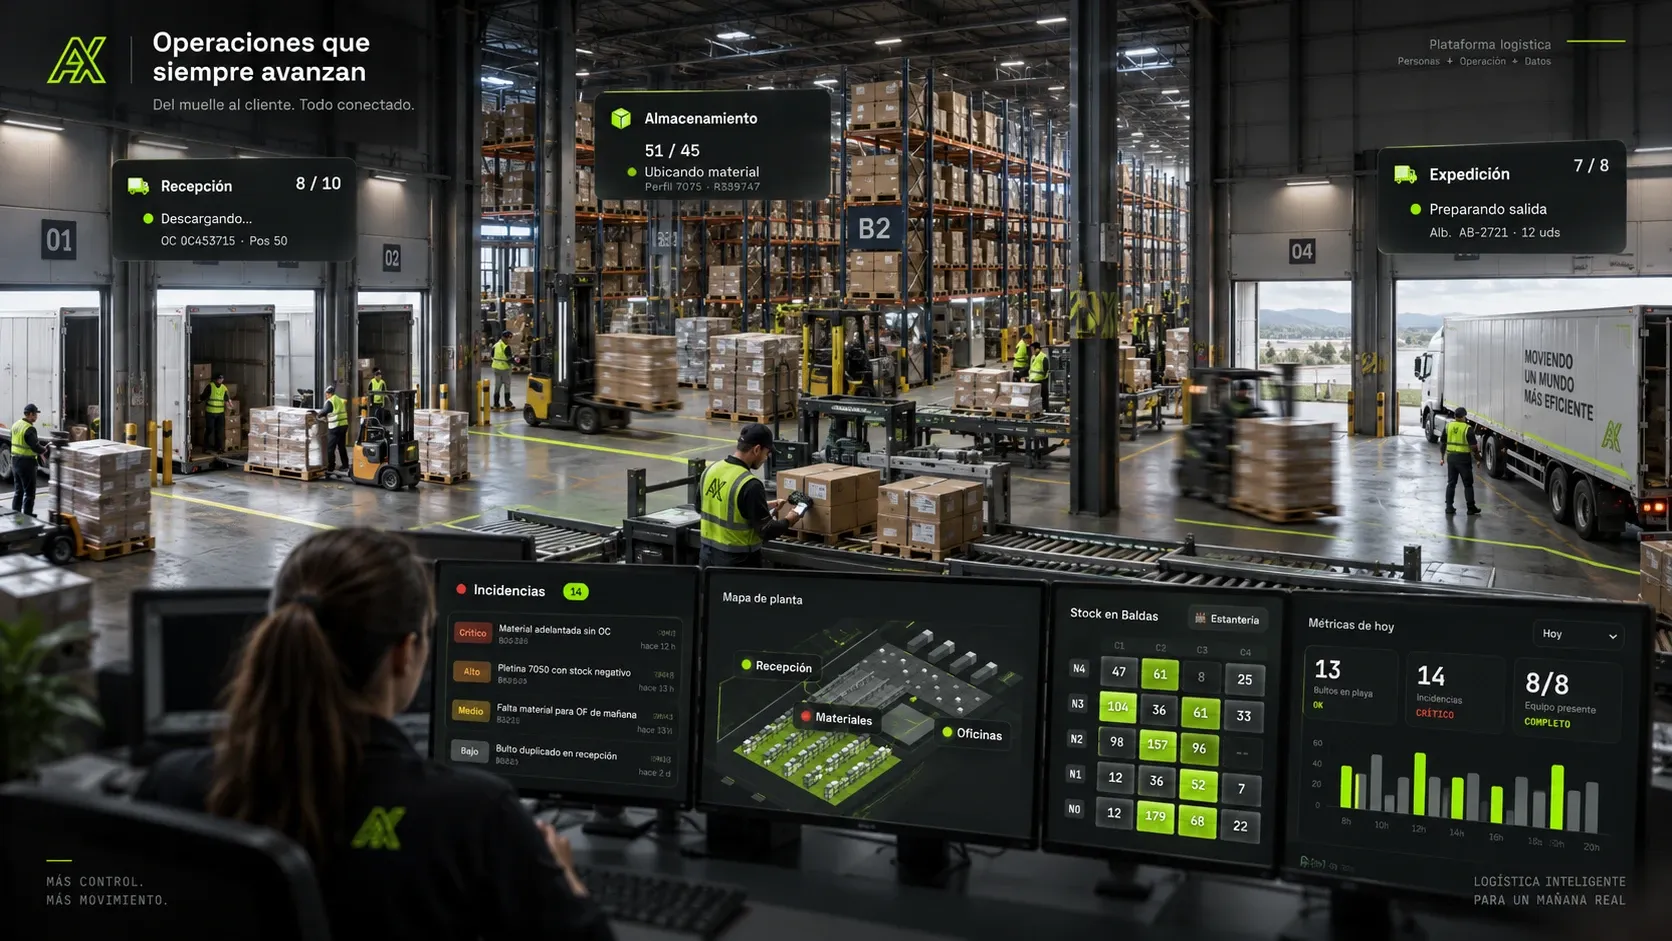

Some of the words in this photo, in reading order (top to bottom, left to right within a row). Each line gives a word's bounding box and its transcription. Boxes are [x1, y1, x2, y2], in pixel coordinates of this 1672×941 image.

[859, 217, 890, 239] B2
[46, 227, 72, 253] 01
[384, 249, 399, 266] 02
[1291, 243, 1313, 260] 04
[1524, 349, 1573, 370] MOVIENDO
[1525, 370, 1536, 385] UN
[1539, 372, 1575, 393] MUNDO
[1524, 388, 1542, 406] MÁS
[1544, 393, 1594, 422] EFICIENTE
[474, 584, 546, 597] Incidencias
[570, 588, 582, 596] 14
[723, 592, 751, 604] Mapa
[754, 594, 767, 604] de
[770, 595, 802, 606] planta
[1070, 608, 1102, 620] Stock
[1105, 610, 1118, 620] en
[1122, 610, 1158, 622] Baldas
[499, 624, 532, 634] Material
[535, 626, 581, 635] adelantada
[584, 627, 596, 636] sin
[598, 627, 611, 636] OC
[1308, 618, 1355, 630] Métricas
[1358, 620, 1372, 632] de
[1374, 621, 1394, 634] hoy
[1542, 629, 1562, 640] Hoy
[1114, 642, 1124, 650] C1
[1156, 644, 1166, 652] C2
[1197, 646, 1208, 654] C3
[1240, 648, 1251, 656] C4
[464, 668, 480, 676] Alto
[498, 664, 526, 673] Pletina
[528, 666, 550, 674] 7050
[570, 666, 592, 676] stock
[594, 668, 631, 678] negativo
[756, 660, 812, 675] Recepción
[1073, 664, 1086, 674] N4
[1112, 667, 1126, 676] 47
[1154, 669, 1167, 680] 61
[1198, 672, 1204, 682] 8
[1238, 674, 1252, 685] 25
[1315, 660, 1341, 680] 13
[1418, 666, 1445, 686] 14
[1525, 672, 1569, 696] 8/8
[1314, 686, 1338, 696] Bultos
[1352, 688, 1373, 699] playa
[458, 706, 484, 716] Medio
[497, 704, 518, 712] Falta
[520, 705, 553, 714] material
[555, 708, 574, 717] para
[576, 708, 588, 716] OF
[1072, 699, 1084, 709] N3
[1108, 702, 1128, 712] 104
[1152, 705, 1166, 716] 36
[1194, 708, 1208, 718] 61
[1236, 710, 1251, 721] 33
[1416, 708, 1454, 720] CRÍTICO
[1525, 702, 1554, 714] Equipo
[1557, 704, 1596, 715] presente
[816, 712, 872, 726] Materiales
[1524, 718, 1570, 728] COMPLETO
[957, 728, 1002, 741] Oficinas
[460, 747, 478, 756] Bajo
[1070, 734, 1082, 744] N2
[1110, 737, 1124, 747] 98
[1148, 740, 1168, 750] 157
[1192, 744, 1206, 754] 96
[496, 745, 517, 754] Bulto
[520, 746, 560, 758] duplicado
[576, 750, 617, 760] recepción
[1070, 770, 1082, 780] N1
[1108, 772, 1122, 782] 12
[1150, 776, 1164, 786] 36
[1192, 780, 1206, 790] 52
[1238, 784, 1245, 794] 7
[1108, 808, 1121, 818] 12
[1146, 811, 1166, 822] 179
[1190, 816, 1204, 826] 68
[1233, 821, 1248, 832] 22
[1375, 821, 1389, 830] 10h
[1412, 825, 1426, 834] 12h
[1584, 842, 1600, 851] 20h
